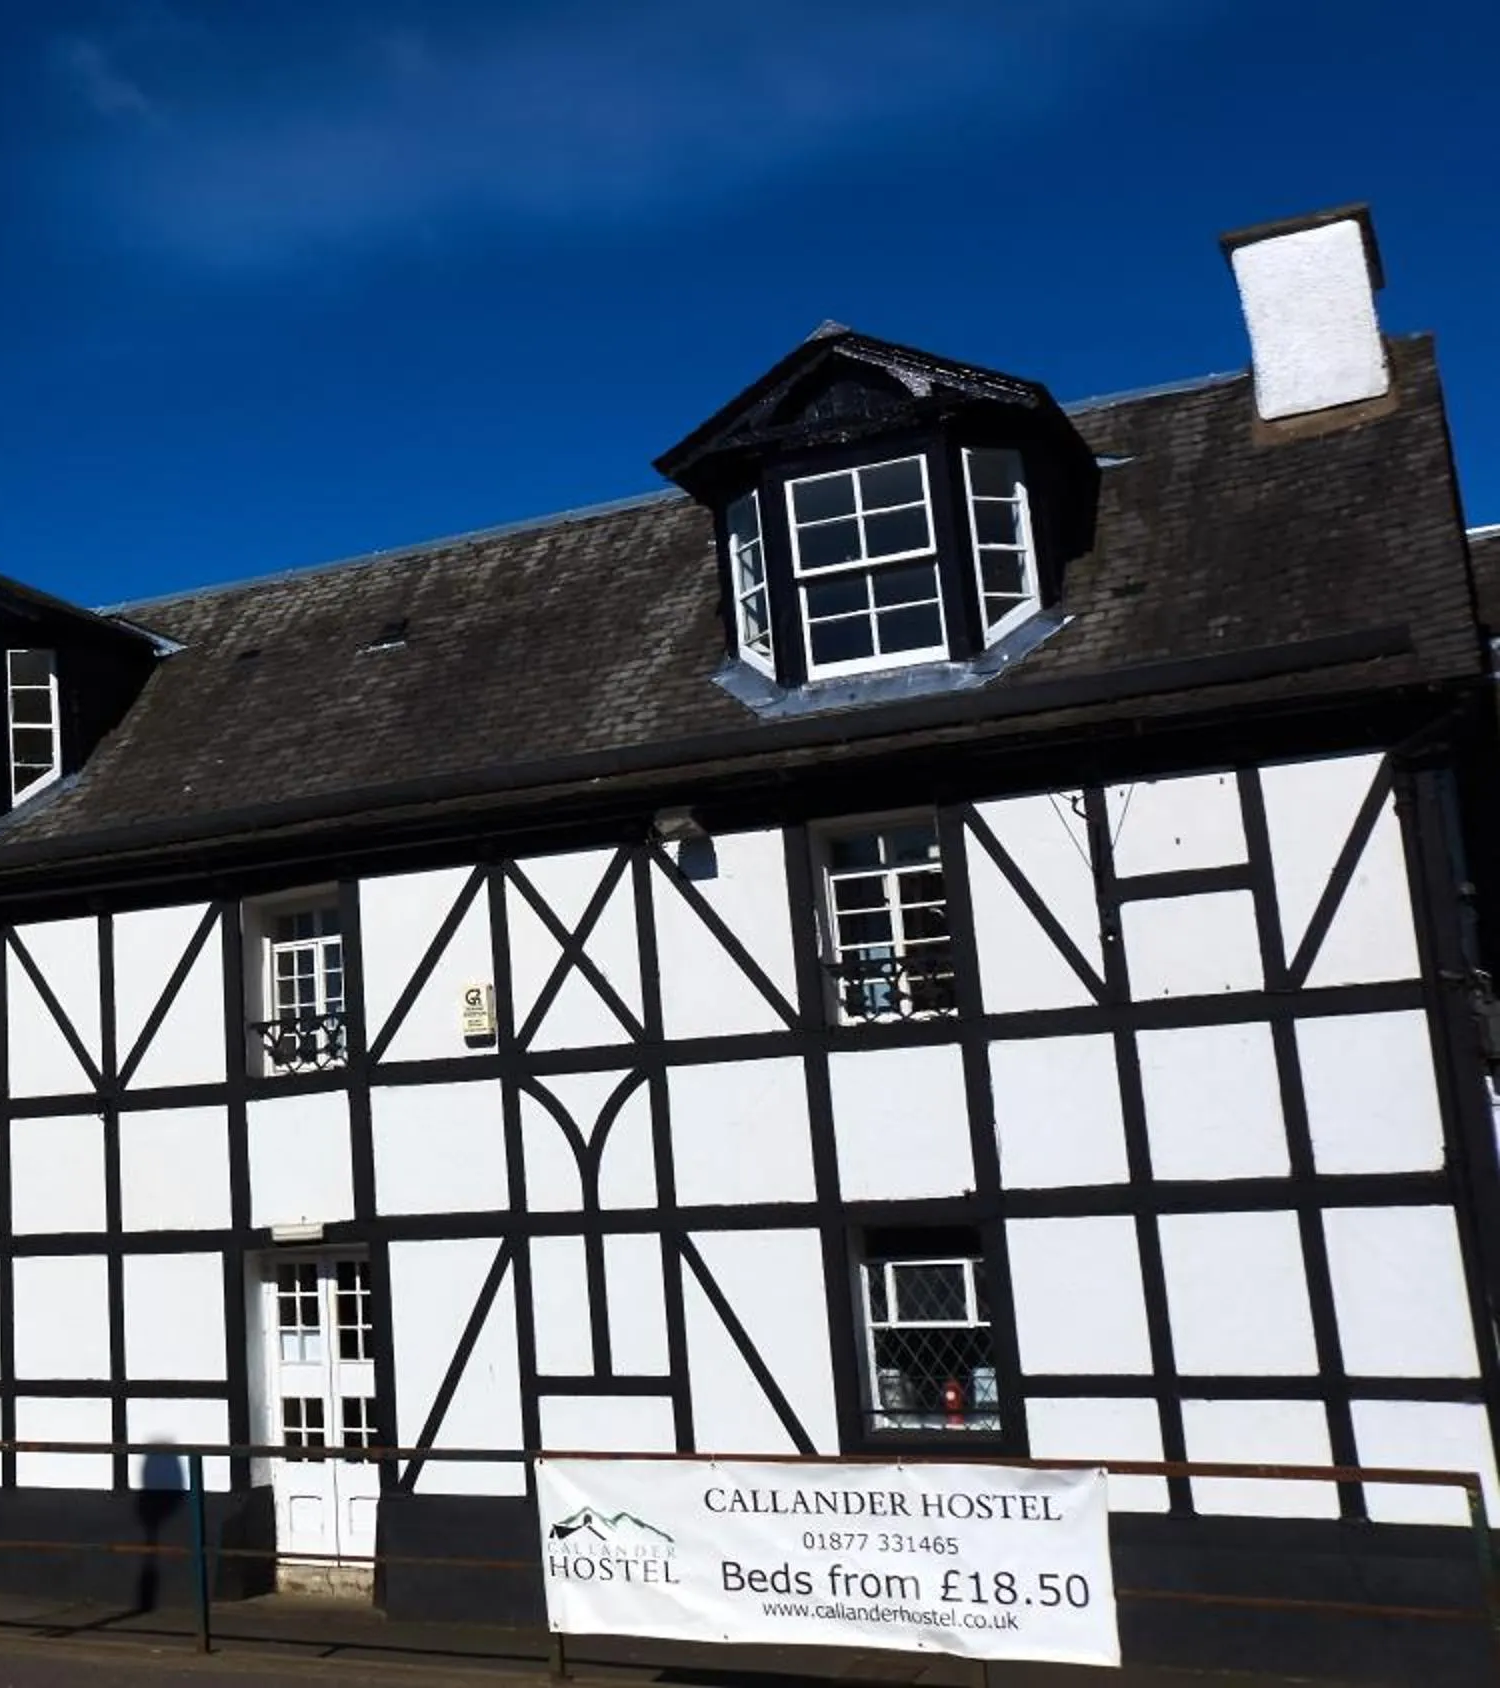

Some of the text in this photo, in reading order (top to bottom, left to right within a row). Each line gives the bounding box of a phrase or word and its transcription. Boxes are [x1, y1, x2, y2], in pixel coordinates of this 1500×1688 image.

[704, 1487, 1063, 1521] CALLANDER HOSTEL
[548, 1540, 677, 1559] CALLANDER
[802, 1531, 959, 1555] 01877 331465
[549, 1555, 681, 1584] HOSTEL
[722, 1560, 1090, 1608] Beds from £18.50
[762, 1601, 1020, 1630] www.callanderhostel.co.uk
